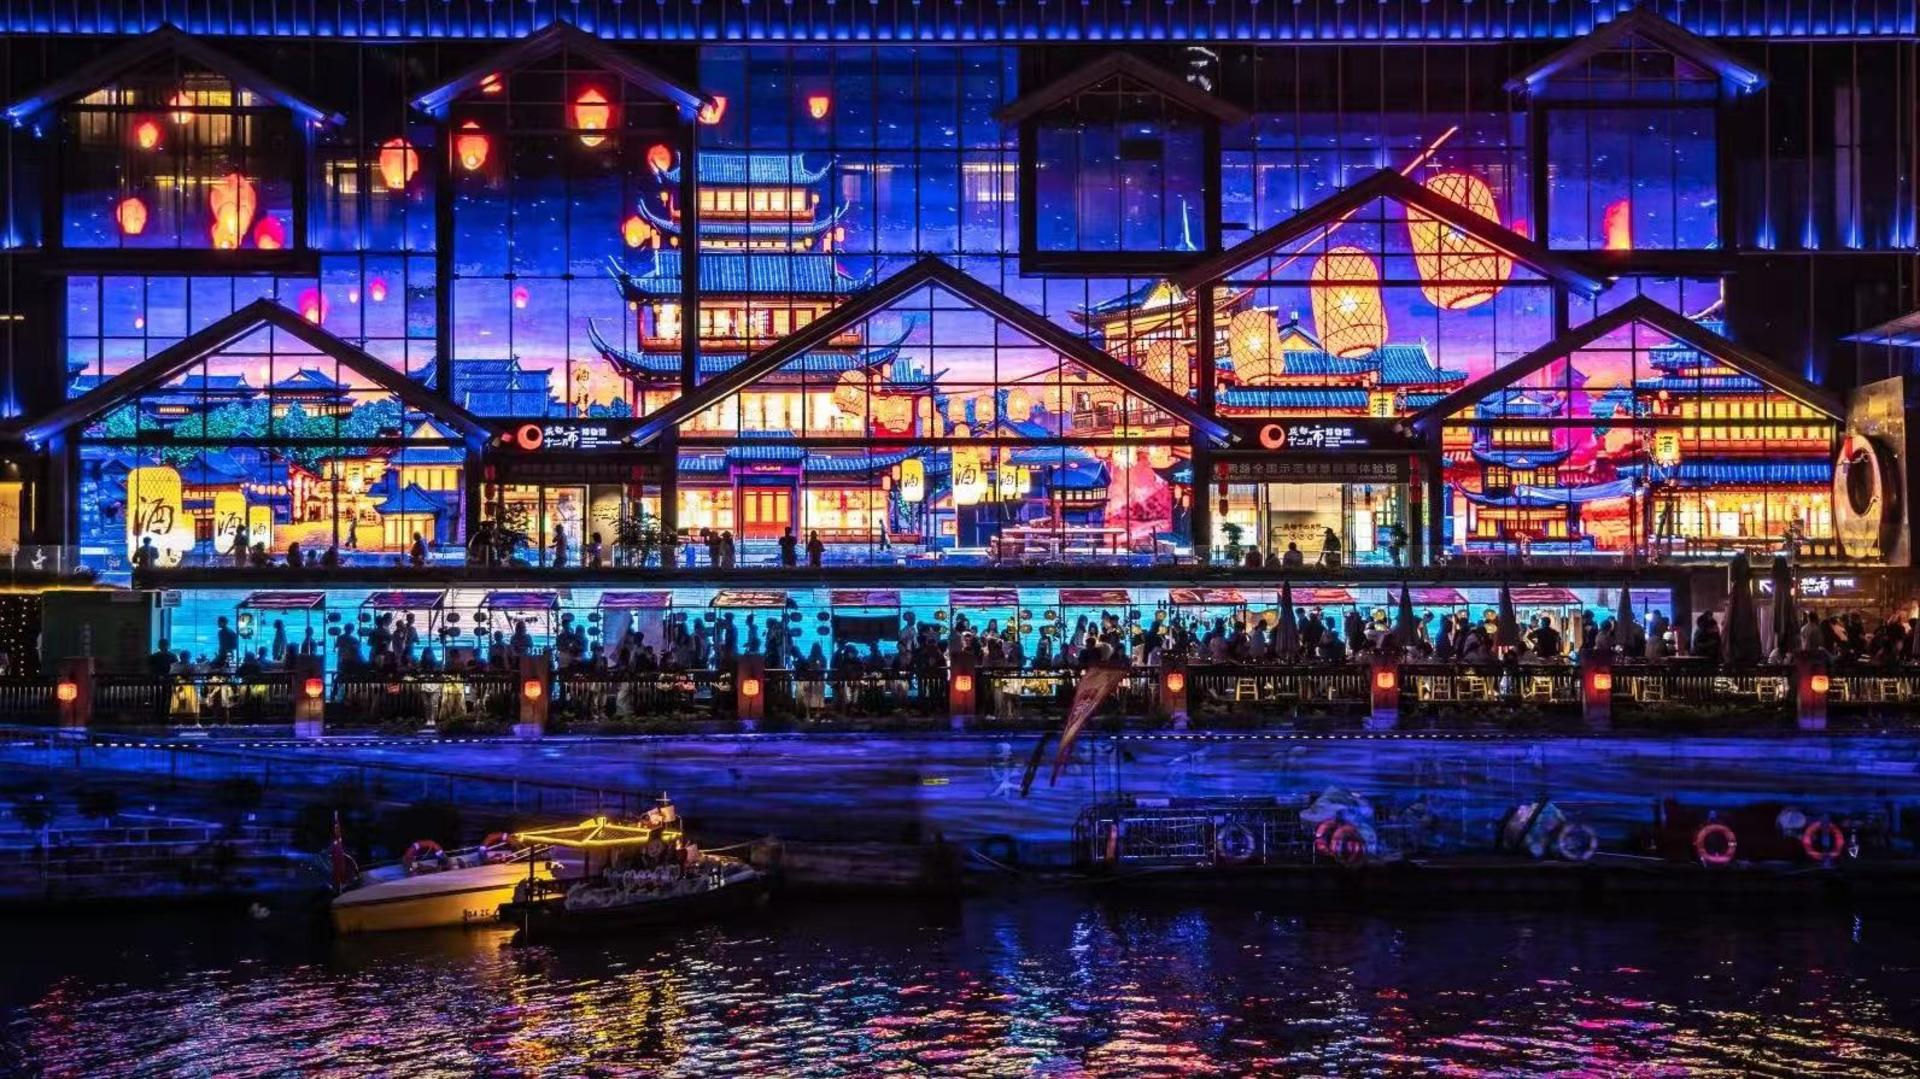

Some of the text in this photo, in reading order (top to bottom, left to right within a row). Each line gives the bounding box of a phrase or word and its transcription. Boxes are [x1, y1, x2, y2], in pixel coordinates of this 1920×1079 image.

[954, 464, 976, 486] 酒
[133, 496, 174, 536] 酒
[218, 511, 242, 536] 酒
